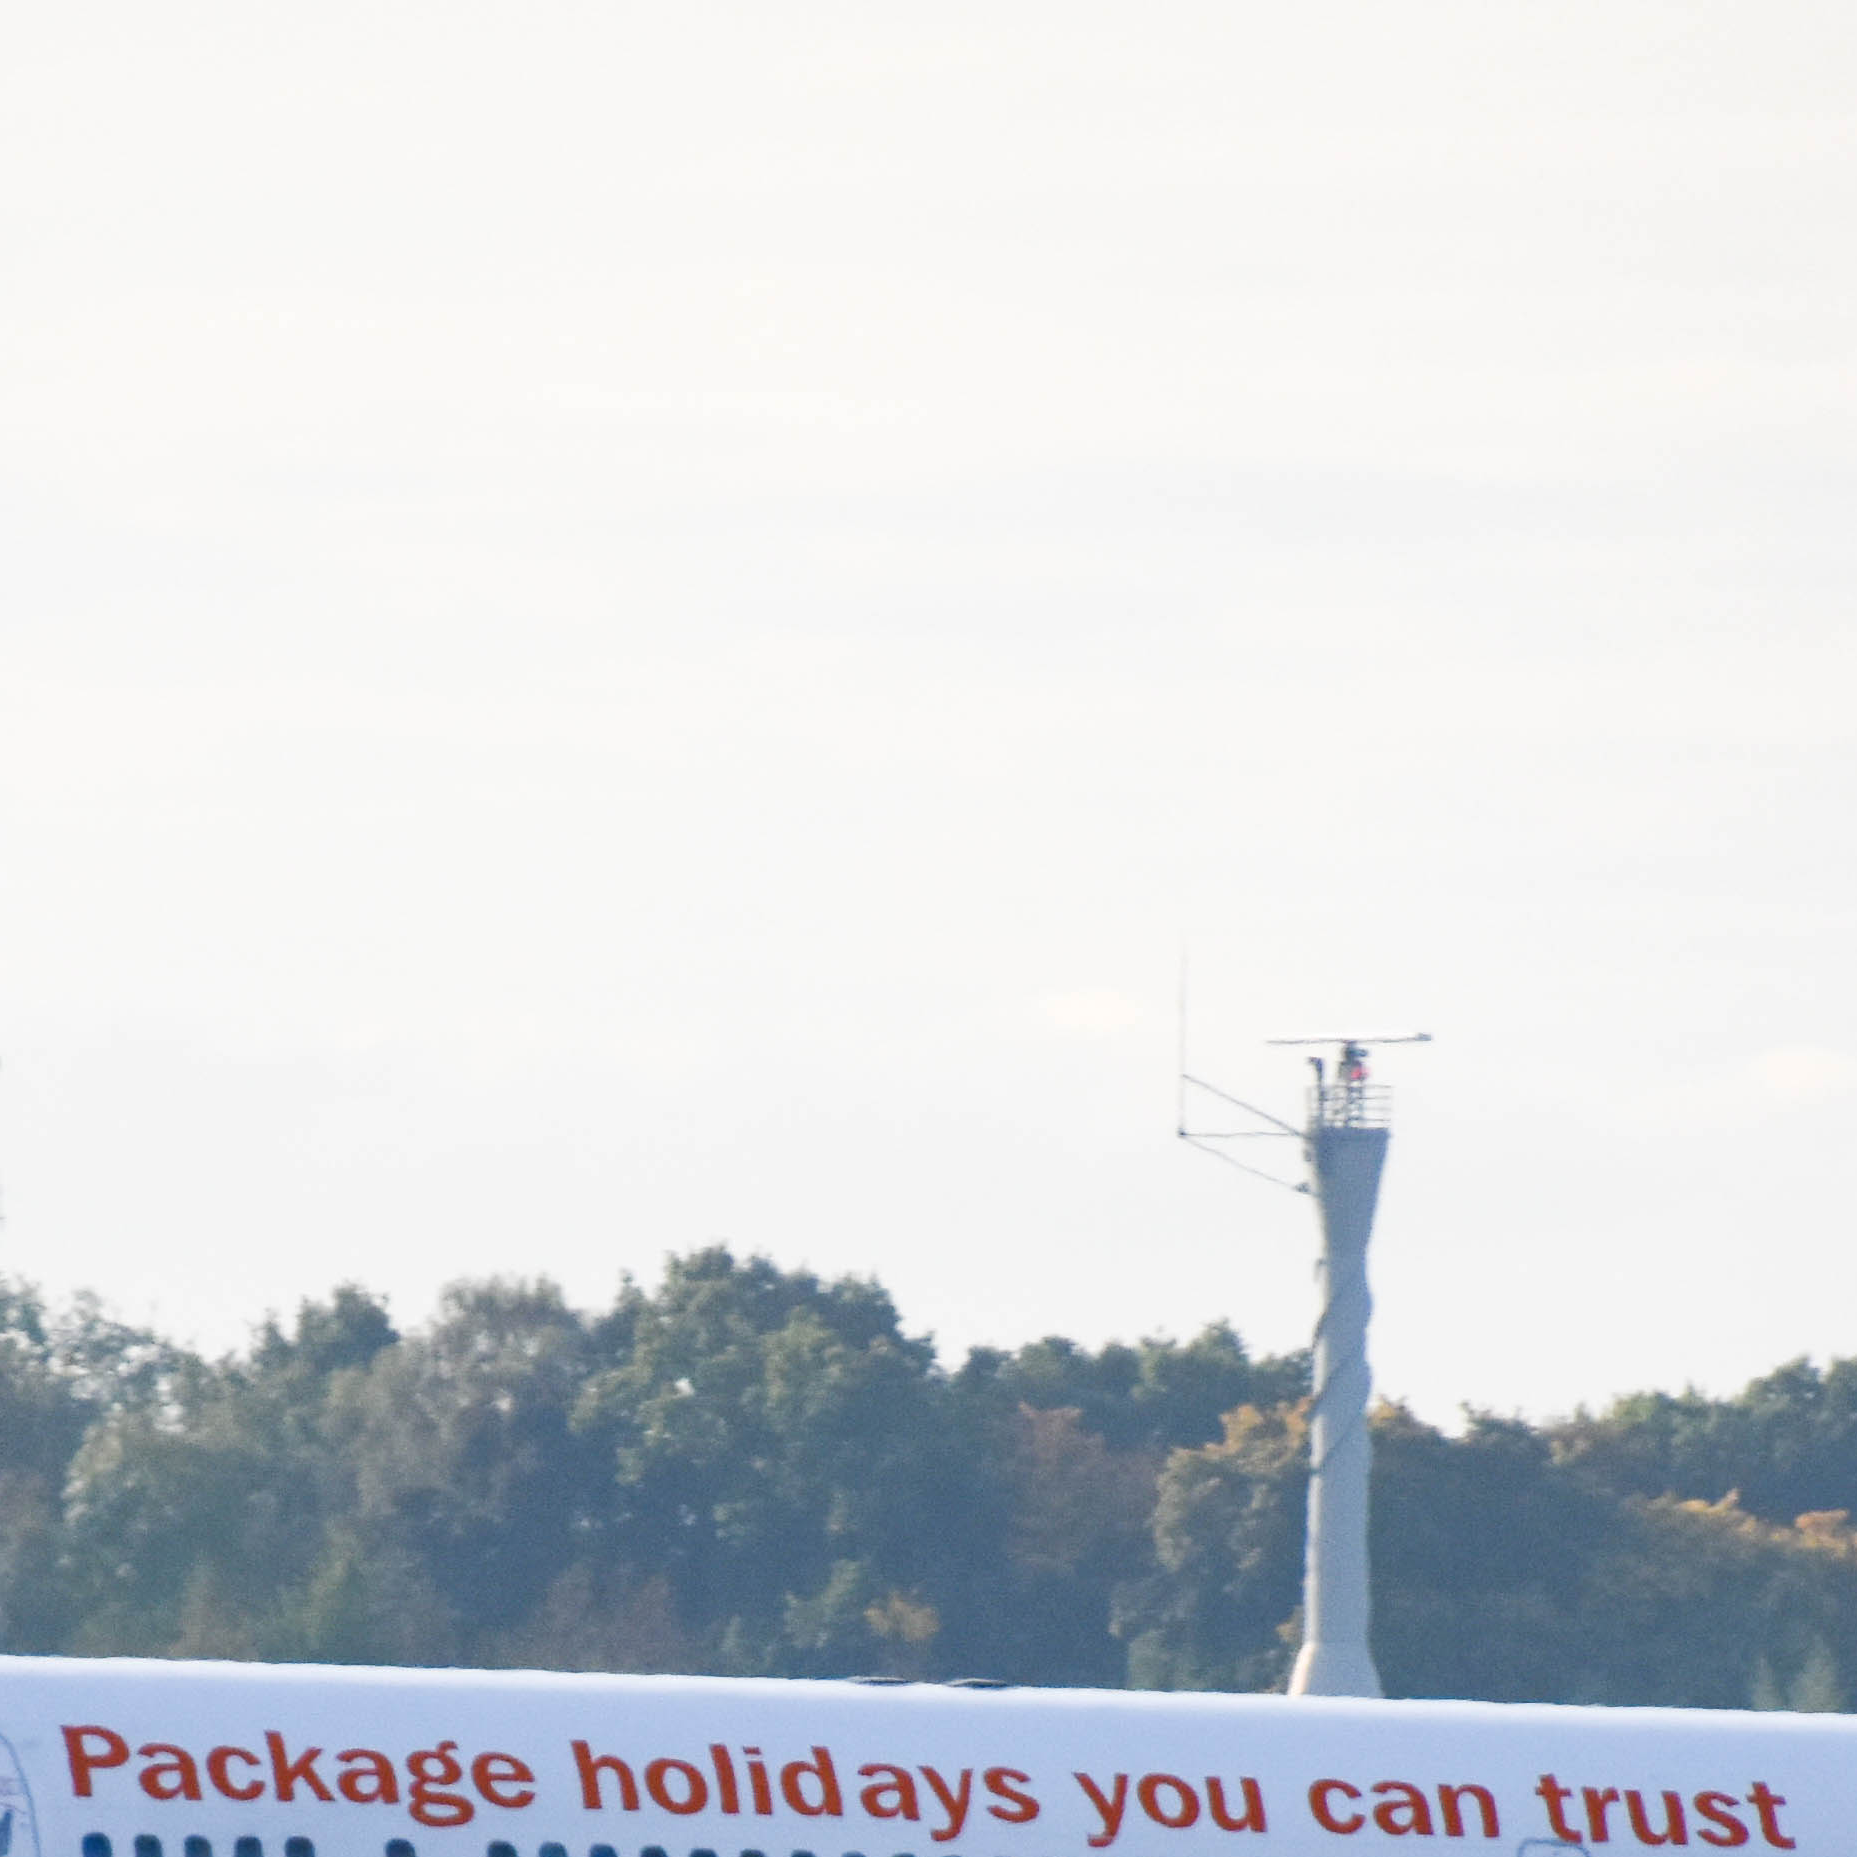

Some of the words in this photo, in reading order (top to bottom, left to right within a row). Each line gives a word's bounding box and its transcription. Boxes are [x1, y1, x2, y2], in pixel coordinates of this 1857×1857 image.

[59, 1724, 536, 1828] Package
[571, 1739, 1041, 1842] holidays
[1074, 1771, 1268, 1847] you
[1308, 1779, 1500, 1838] can
[1535, 1773, 1796, 1849] trust
